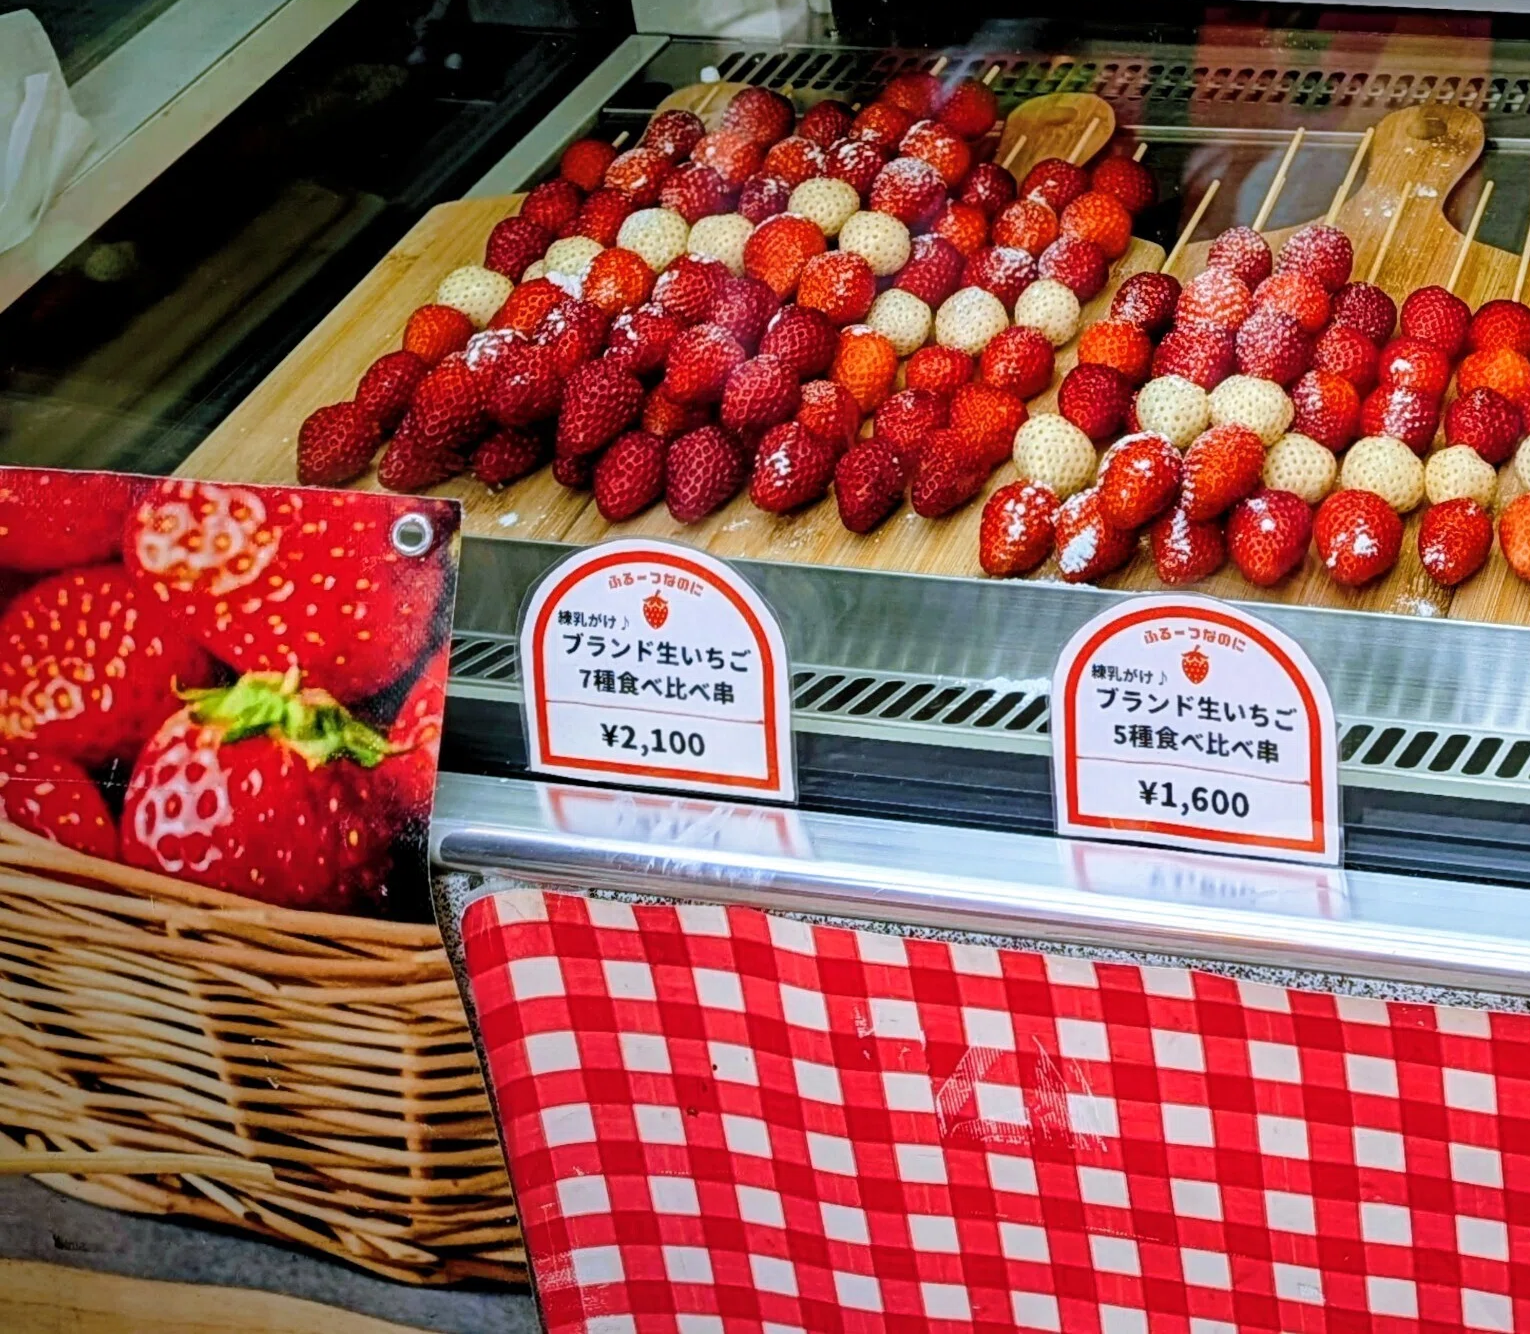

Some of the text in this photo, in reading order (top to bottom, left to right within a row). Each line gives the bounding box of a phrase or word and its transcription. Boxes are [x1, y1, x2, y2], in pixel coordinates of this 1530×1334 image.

[608, 571, 705, 597] ふるーつなのに
[562, 633, 752, 673] ブランド生いちご
[1143, 626, 1247, 653] ふるーつなのに
[579, 668, 736, 705] 7種食べ比べ串
[1096, 686, 1298, 732] ブランド生いちご
[600, 723, 706, 757] ¥2,100
[1113, 723, 1280, 764] 5種食べ比べ串
[1138, 780, 1250, 818] ¥1,600
